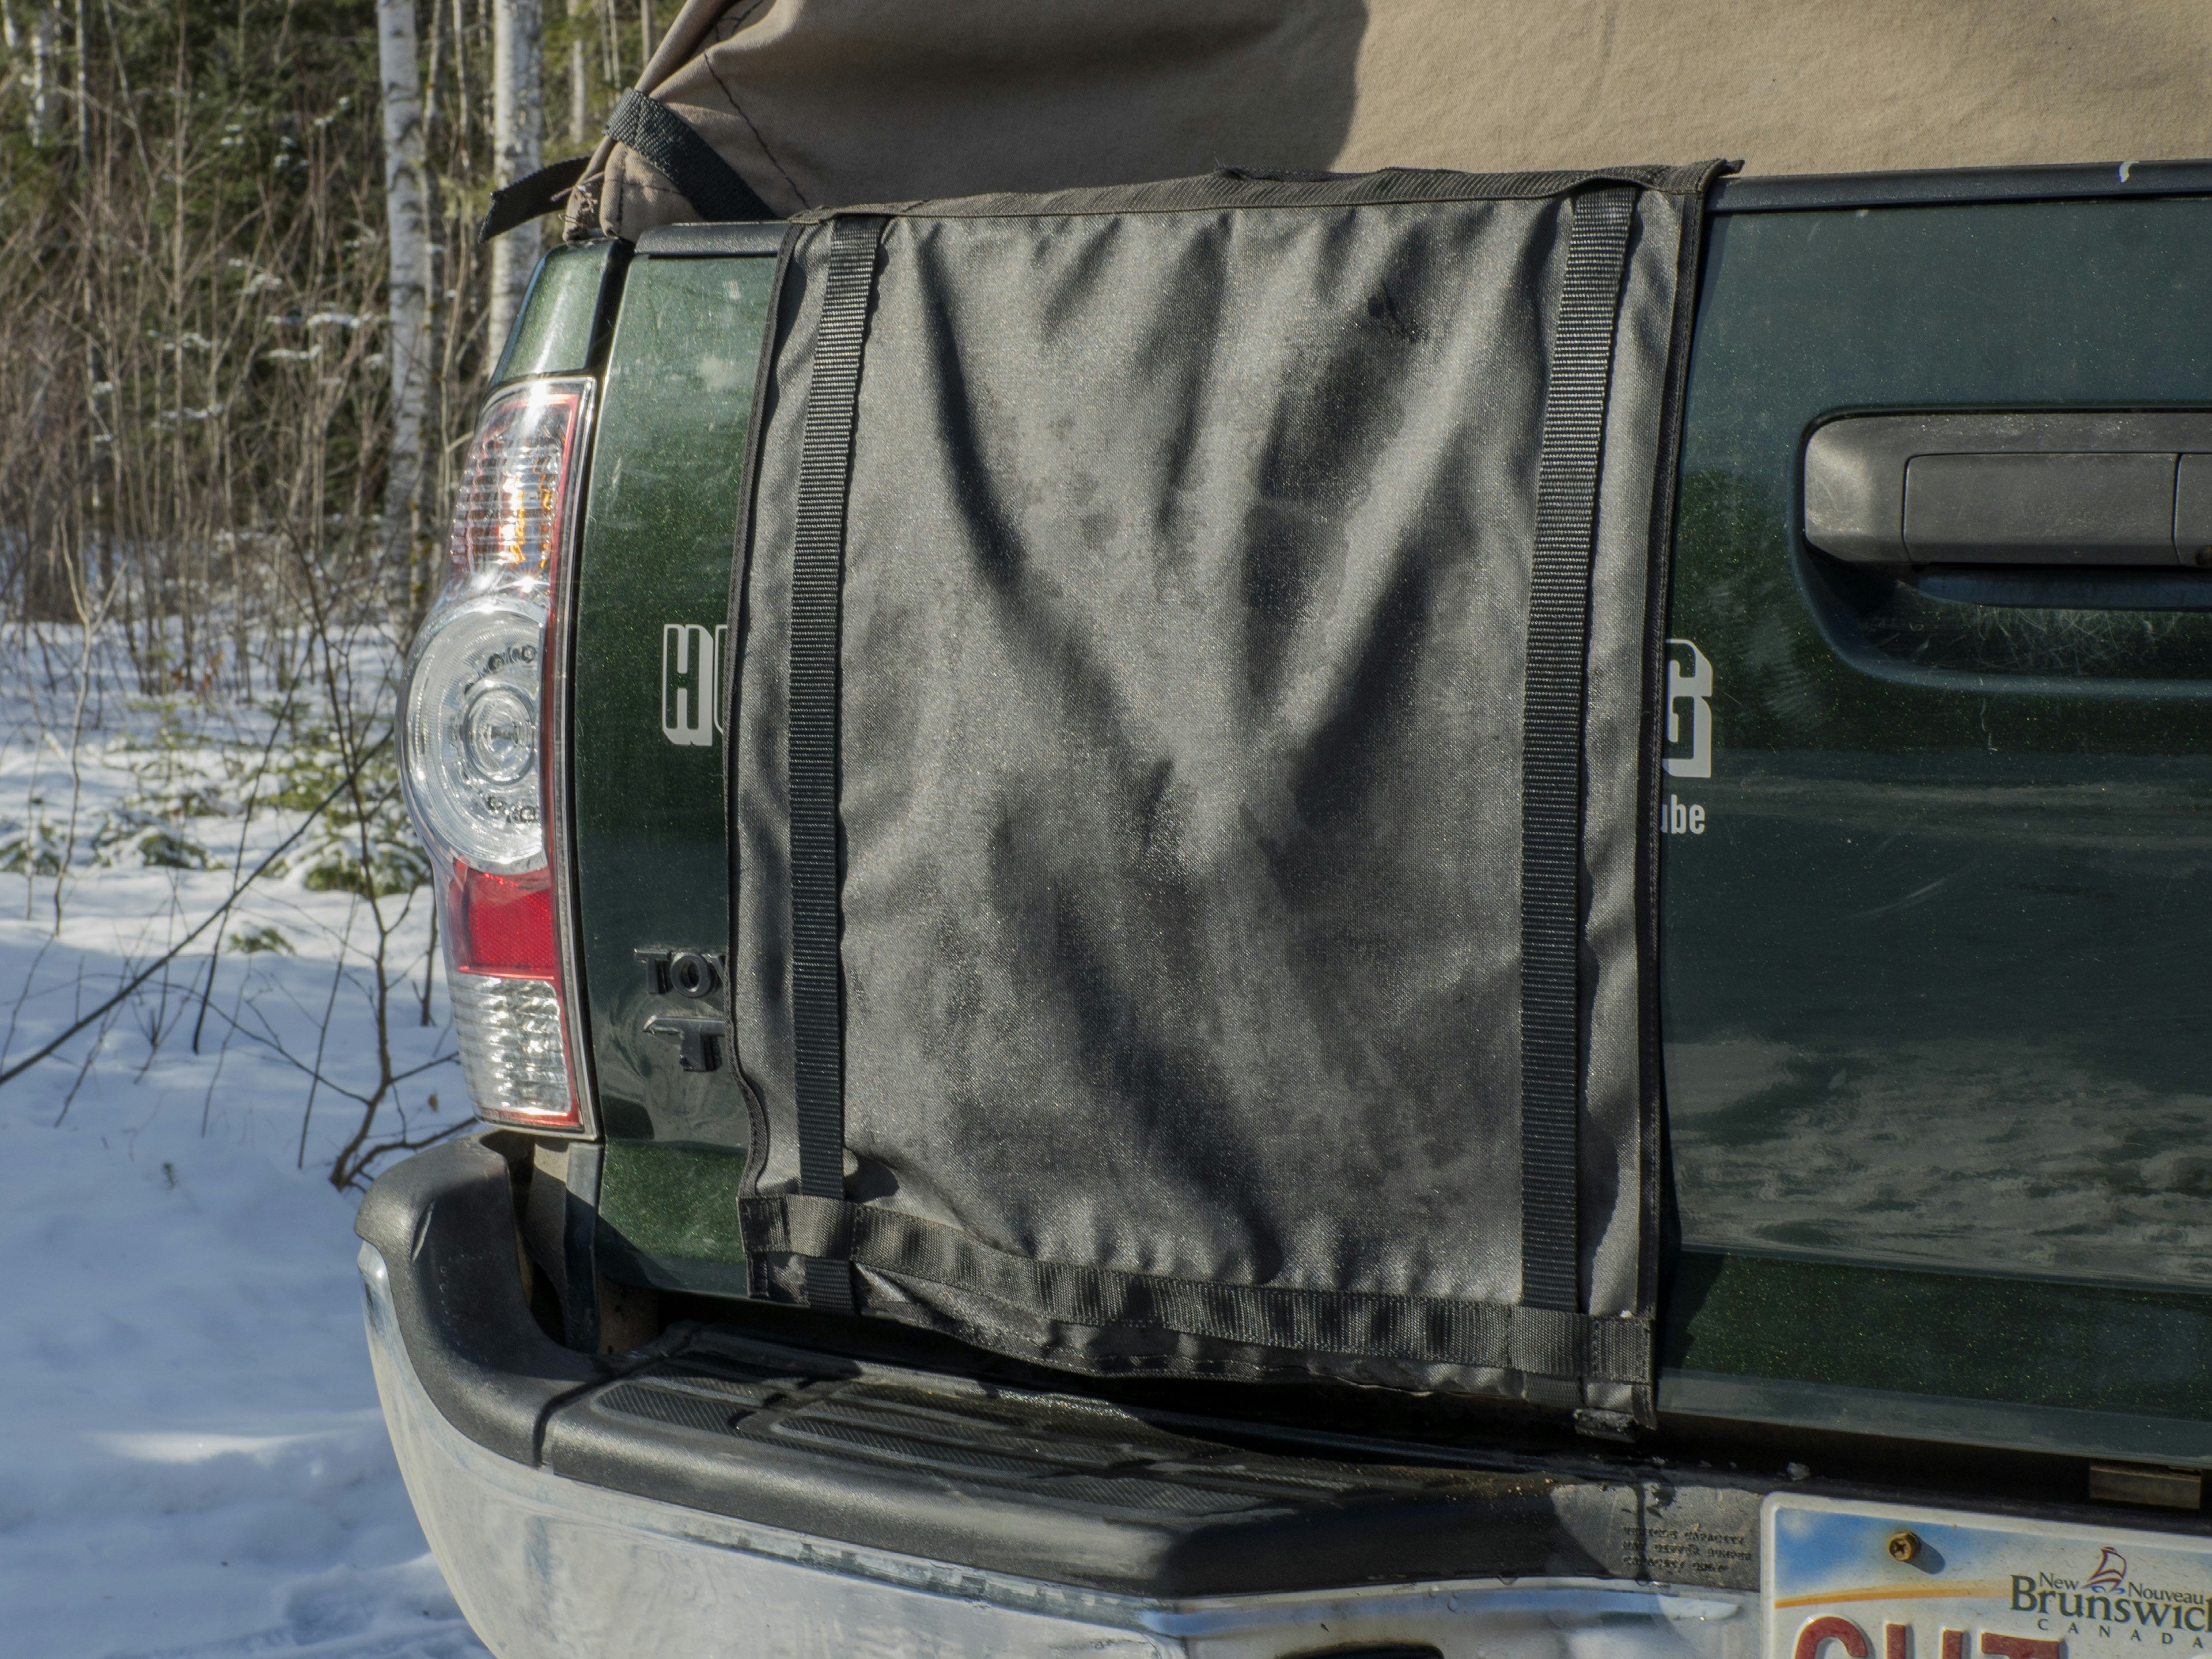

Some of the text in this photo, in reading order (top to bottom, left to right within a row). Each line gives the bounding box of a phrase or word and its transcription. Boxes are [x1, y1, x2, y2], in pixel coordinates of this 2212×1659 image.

[2039, 1571, 2204, 1605] New Nouveau
[2037, 1618, 2204, 1649] CANADA
